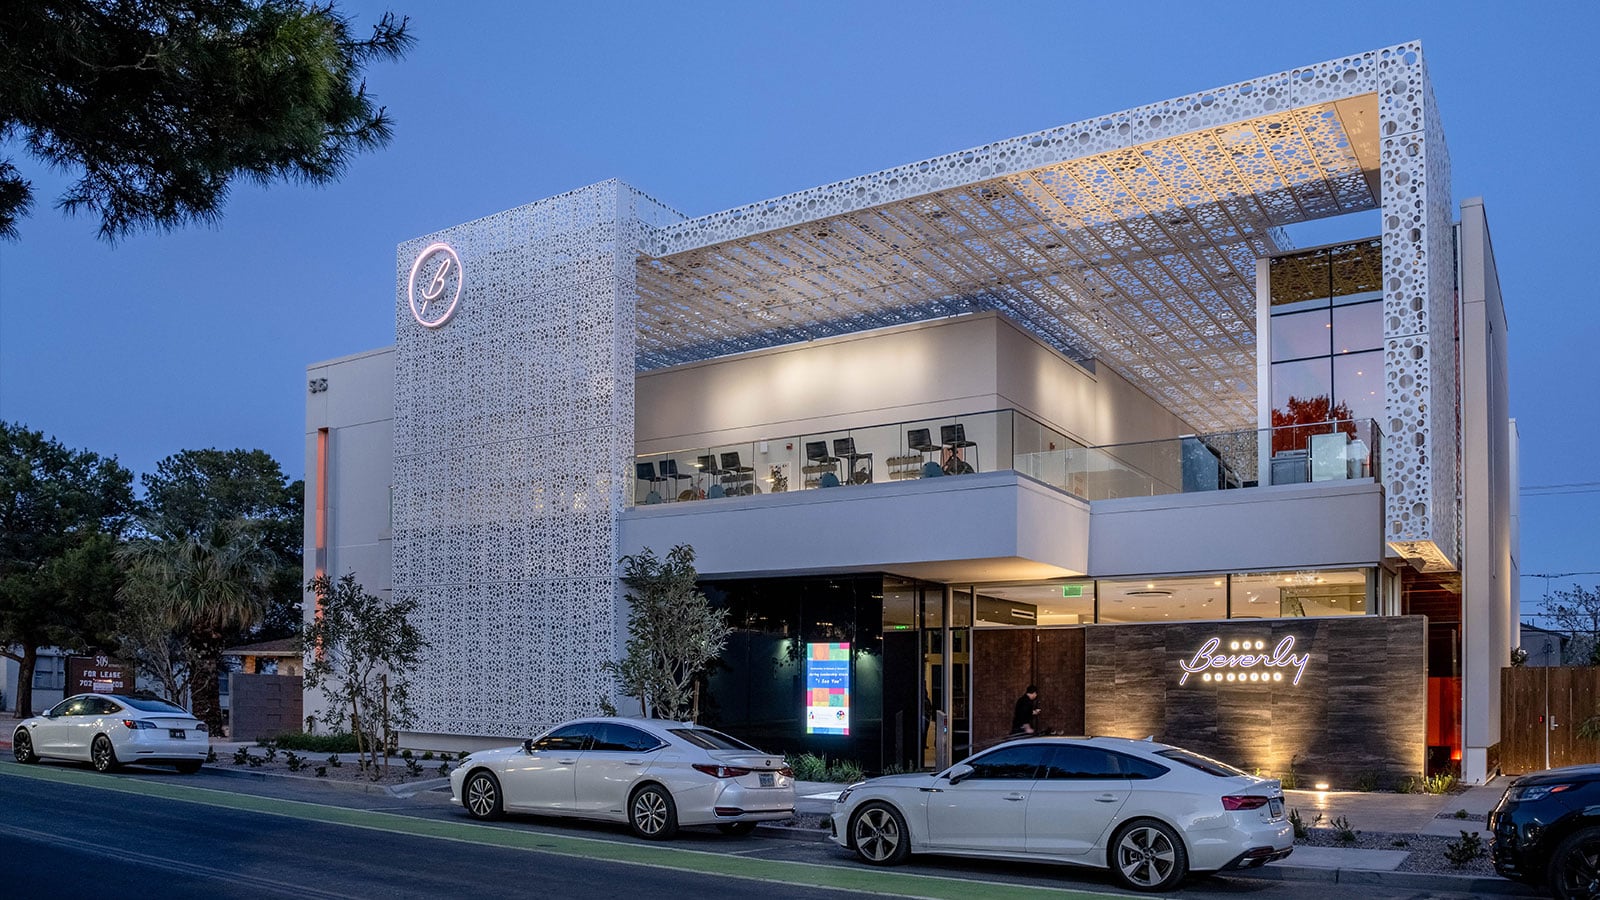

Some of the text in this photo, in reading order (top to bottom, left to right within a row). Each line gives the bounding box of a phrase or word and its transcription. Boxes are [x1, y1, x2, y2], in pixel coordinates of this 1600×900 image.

[1231, 640, 1264, 650] THE
[95, 655, 109, 667] 509
[1179, 635, 1310, 685] Beverly
